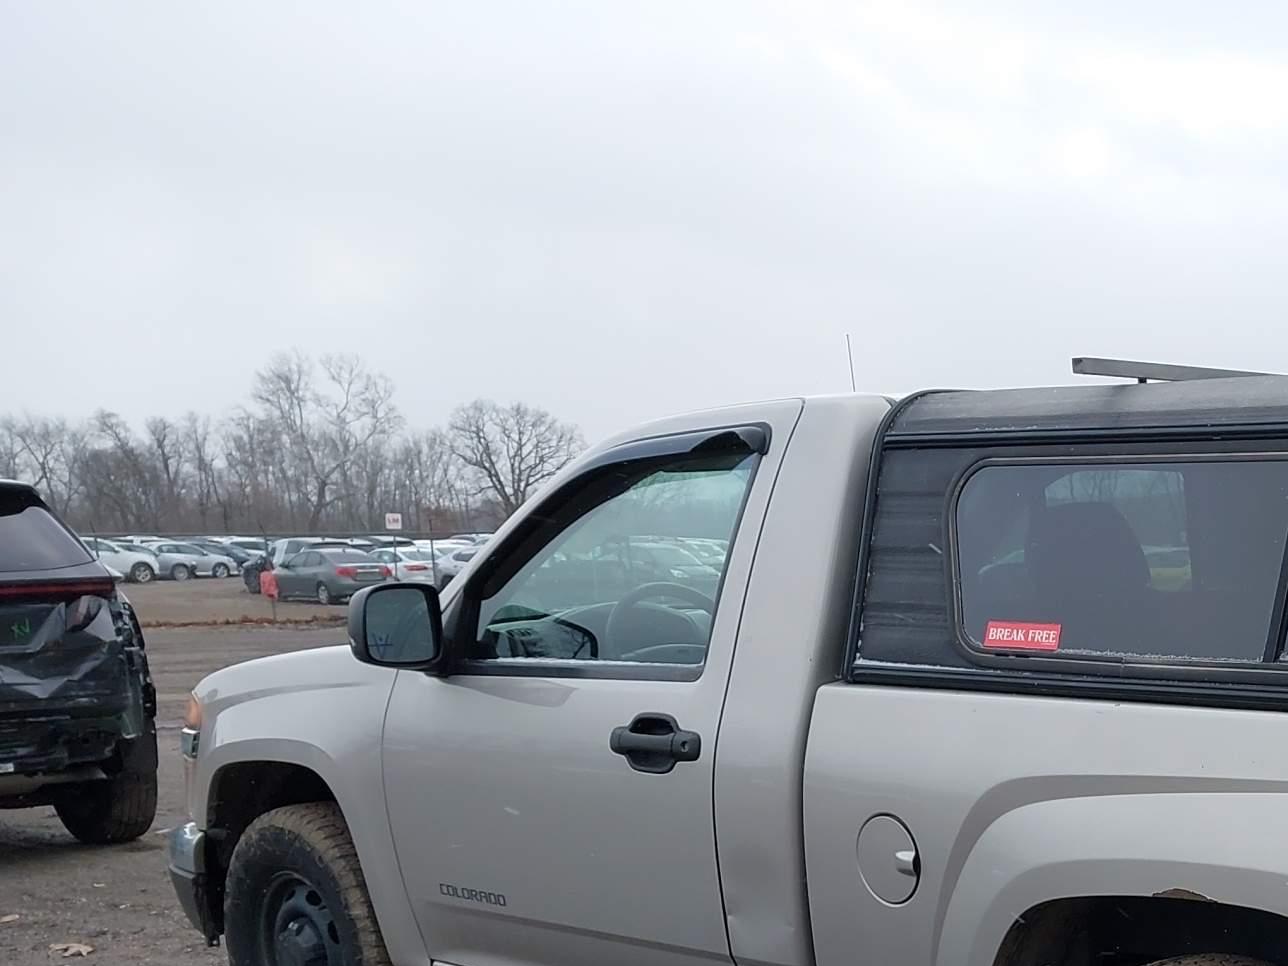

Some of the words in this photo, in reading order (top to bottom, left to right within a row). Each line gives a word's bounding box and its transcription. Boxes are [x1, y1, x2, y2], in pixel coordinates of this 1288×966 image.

[988, 627, 1026, 642] BREAK
[1027, 629, 1057, 644] FREE
[439, 883, 507, 907] COLORADO
